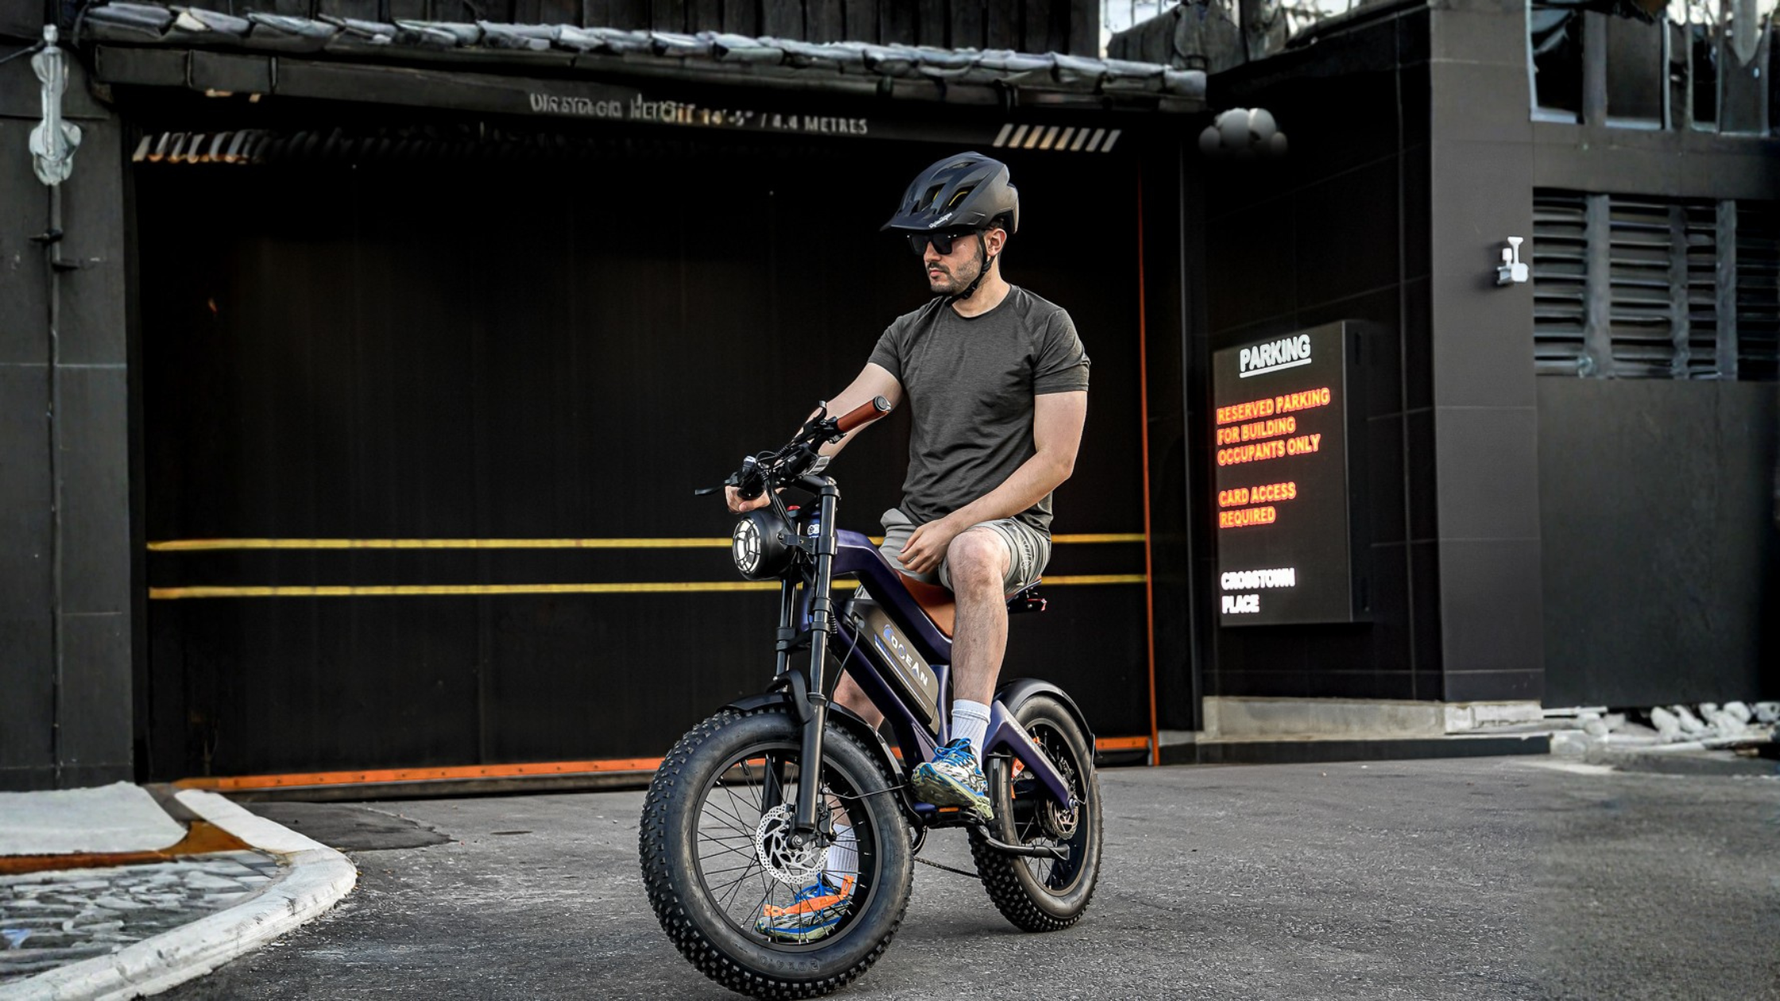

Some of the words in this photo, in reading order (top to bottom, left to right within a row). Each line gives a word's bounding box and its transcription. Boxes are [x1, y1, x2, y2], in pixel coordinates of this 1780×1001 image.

[804, 115, 868, 134] METRES
[1240, 334, 1311, 372] PARKING
[1217, 398, 1274, 425] RESERVED
[1275, 387, 1331, 414] PARKING
[1217, 426, 1240, 446] FOR
[1241, 416, 1296, 442] BUILDING
[1217, 439, 1286, 466] OCCUPANTS
[1286, 433, 1321, 456] ONLY
[1218, 487, 1249, 507] CARD
[1250, 481, 1297, 504] ACCESS
[1219, 506, 1276, 528] REQUIRED
[1221, 594, 1260, 614] PLACE
[890, 635, 928, 686] OCEAN
